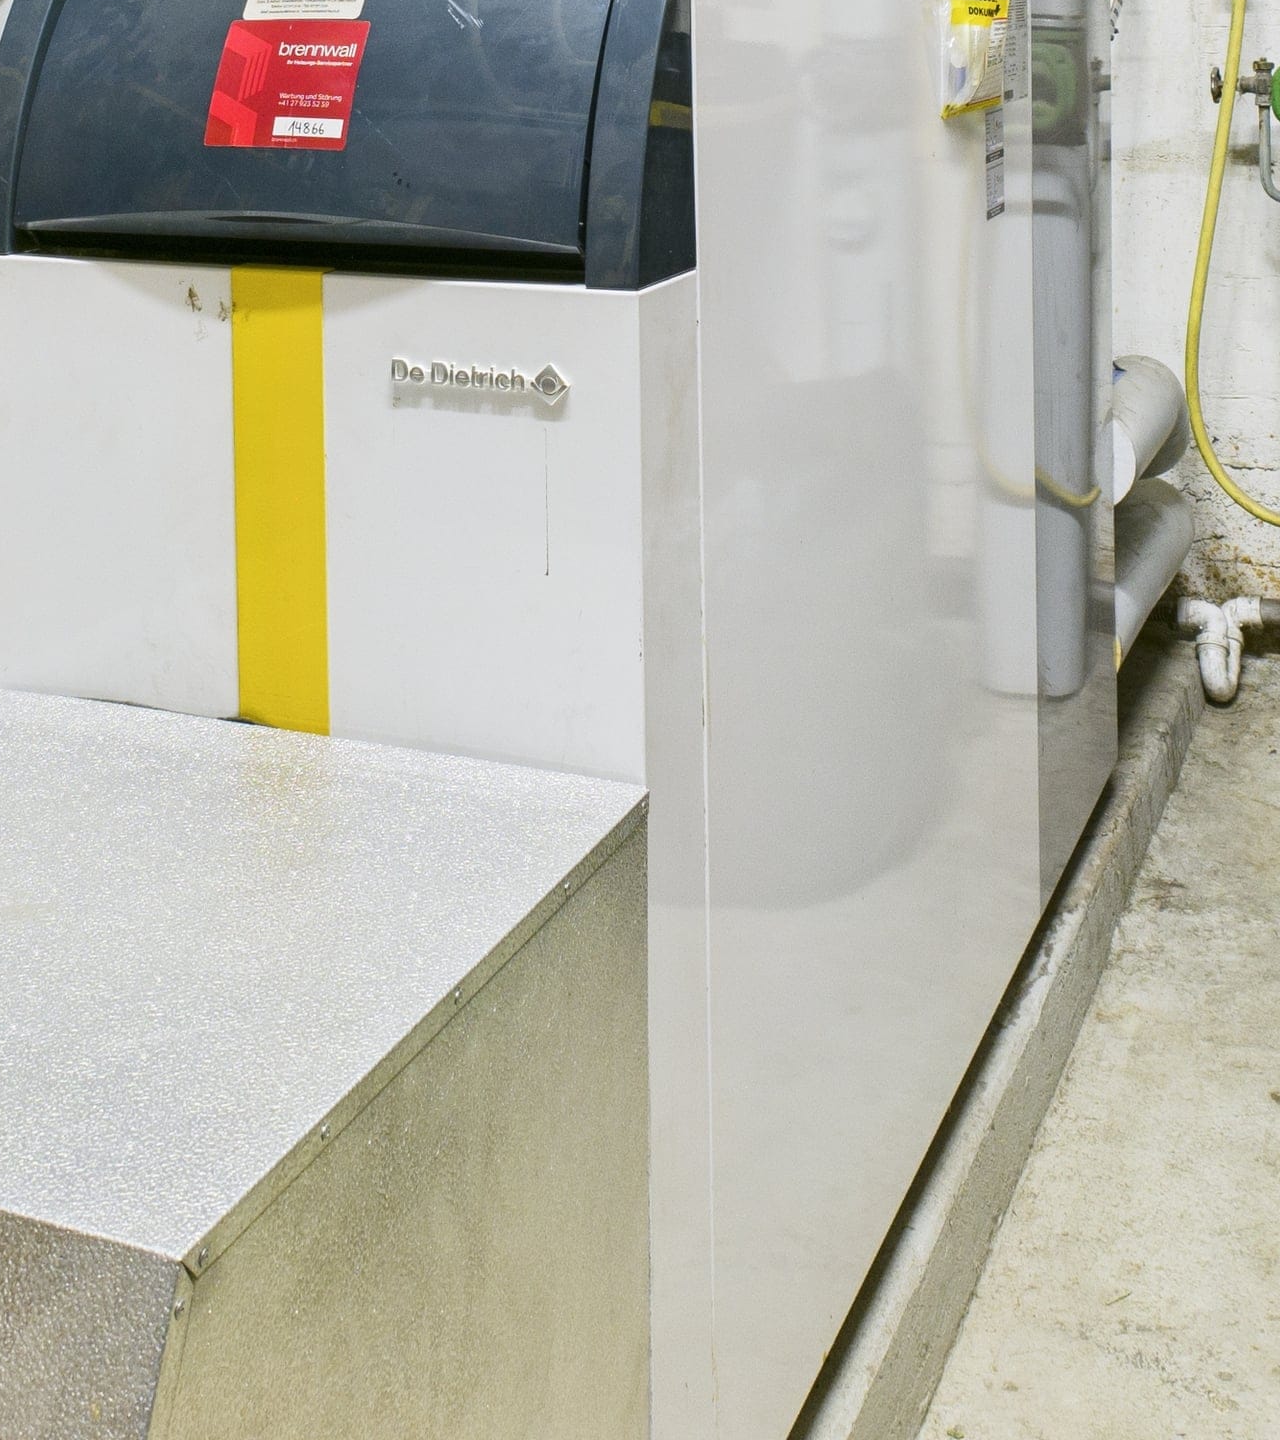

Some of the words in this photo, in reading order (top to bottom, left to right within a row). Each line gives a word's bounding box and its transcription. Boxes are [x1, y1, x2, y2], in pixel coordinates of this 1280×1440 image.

[278, 42, 357, 58] brennwall
[279, 93, 305, 101] Wartung
[305, 93, 318, 101] und
[318, 93, 343, 102] Störung
[287, 120, 325, 136] 14866
[391, 358, 425, 384] De
[431, 361, 526, 392] Dietrich
